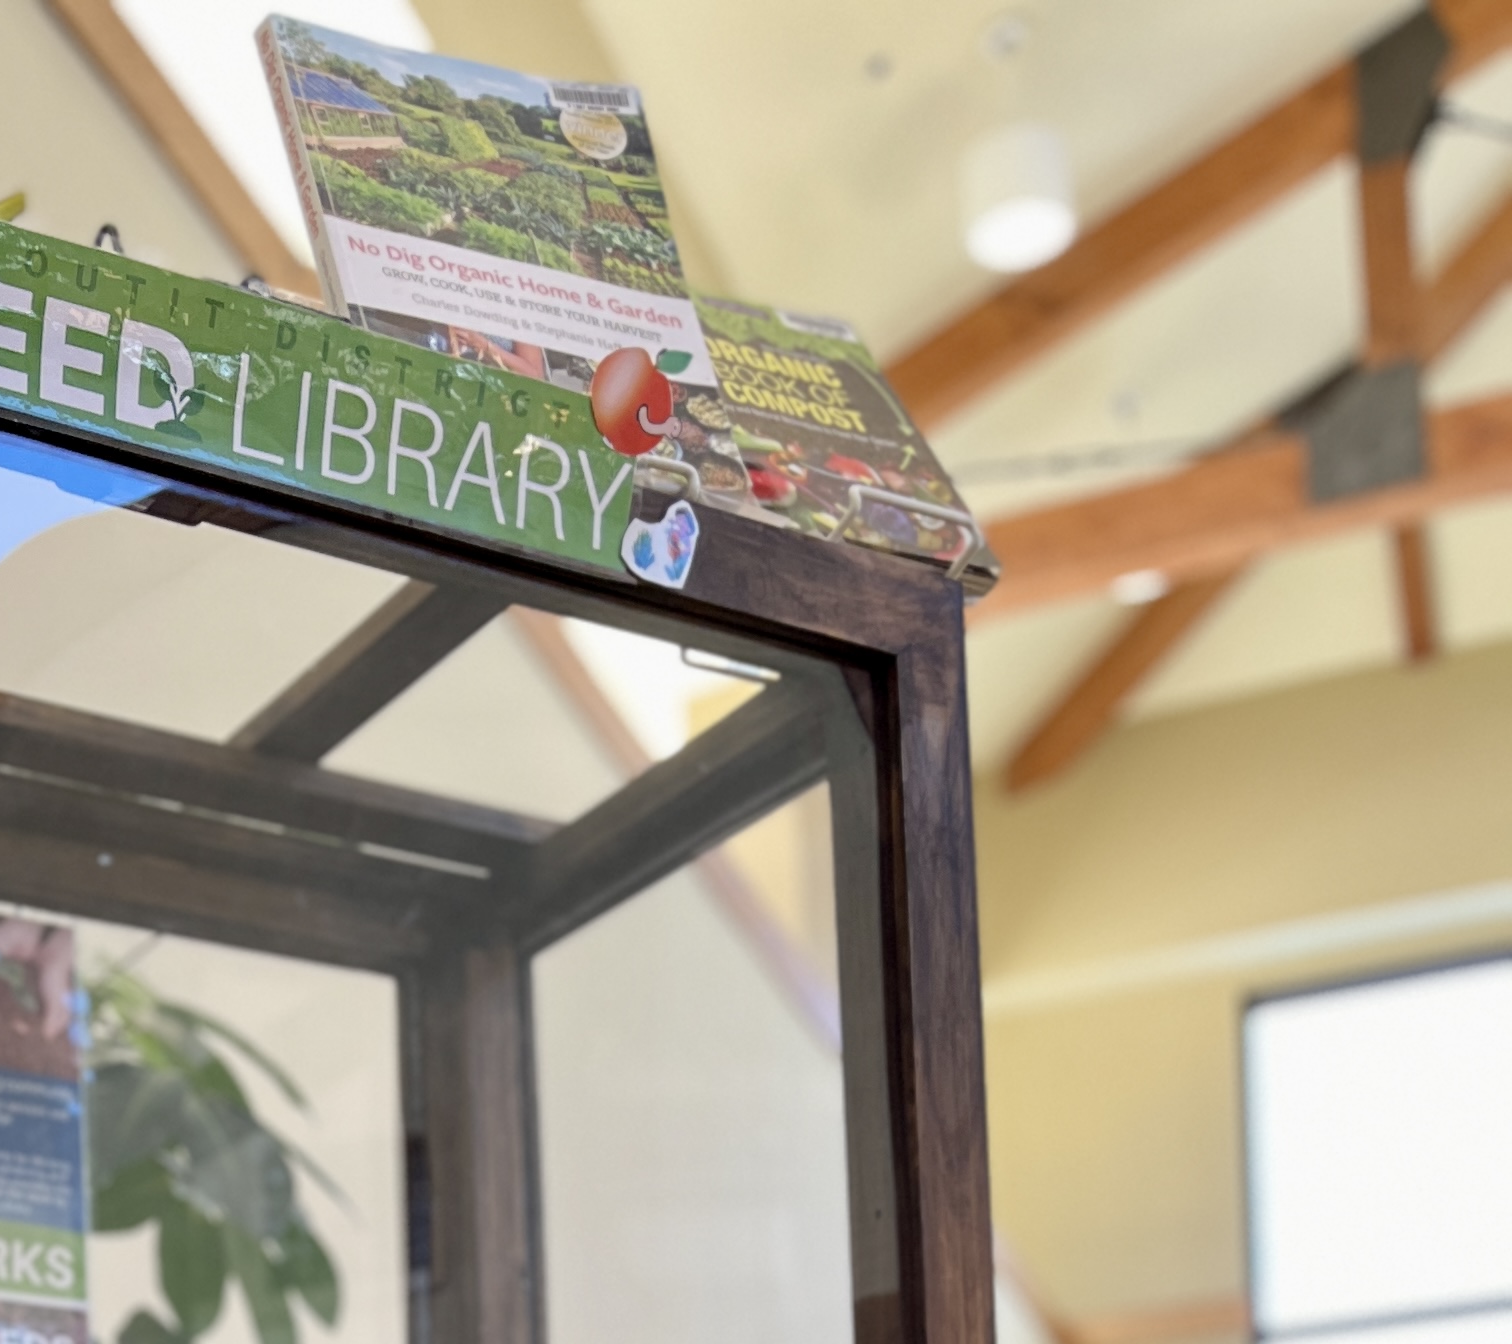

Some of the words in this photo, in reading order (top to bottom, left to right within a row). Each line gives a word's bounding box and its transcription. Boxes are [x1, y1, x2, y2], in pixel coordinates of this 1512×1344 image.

[346, 234, 380, 258] No
[385, 244, 424, 272] Dig
[429, 253, 514, 290] Organic
[518, 273, 581, 305] Home
[586, 290, 603, 310] &
[607, 296, 684, 330] Garden
[381, 265, 429, 287] GROW,
[430, 276, 473, 298] COOK,
[474, 286, 502, 304] USE
[505, 294, 516, 307] &
[519, 298, 563, 318] STORE
[564, 307, 600, 327] YOUR
[603, 319, 663, 344] HARVEST
[714, 361, 806, 400] BOOK
[809, 382, 851, 408] OF
[722, 380, 868, 434] COMPOST
[232, 353, 633, 551] LIBRARY
